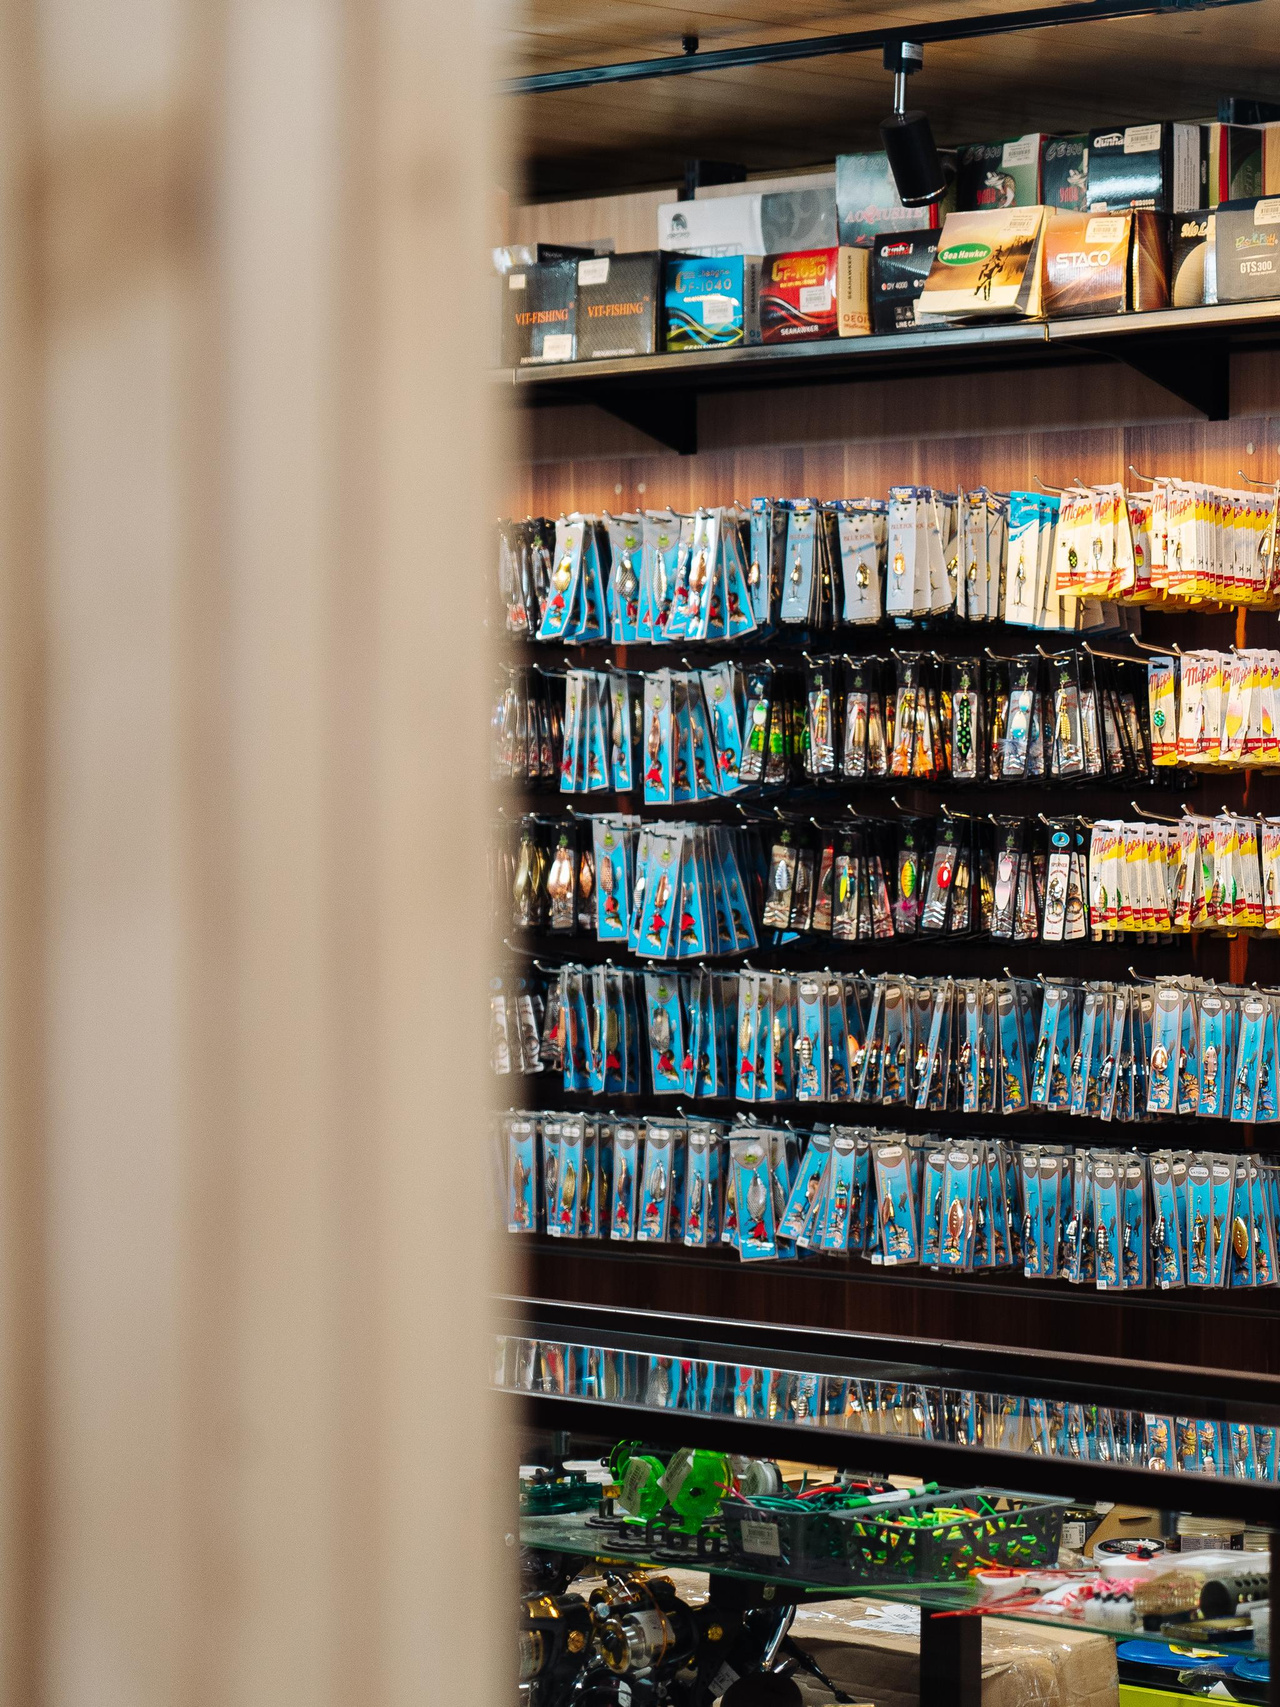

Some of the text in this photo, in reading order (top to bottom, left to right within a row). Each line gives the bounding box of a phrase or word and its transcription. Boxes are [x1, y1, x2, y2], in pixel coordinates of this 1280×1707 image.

[942, 248, 988, 260] Sea Hawker
[1056, 250, 1111, 269] STACO
[515, 308, 569, 326] VIT-FISHING
[587, 302, 644, 318] VIT-FISHING
